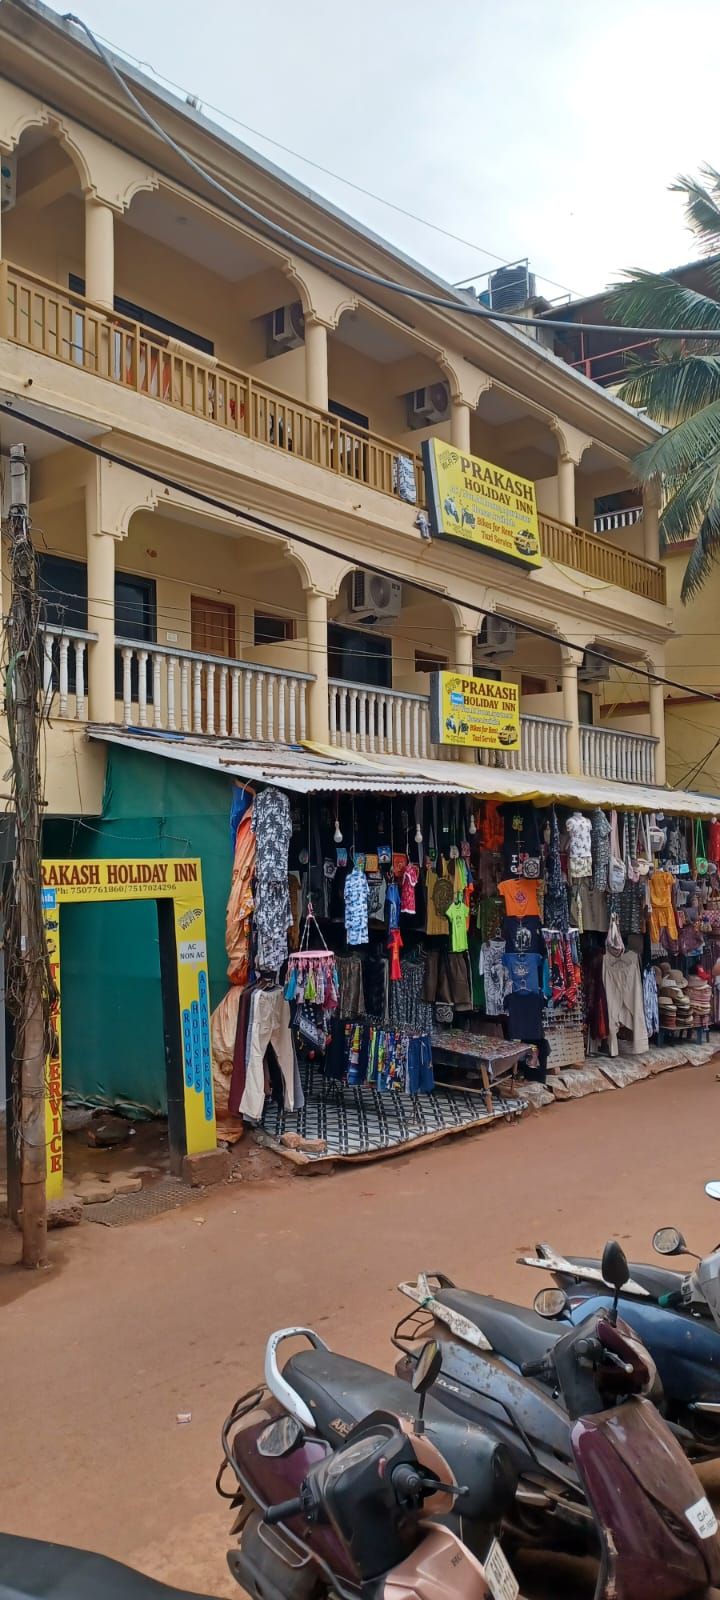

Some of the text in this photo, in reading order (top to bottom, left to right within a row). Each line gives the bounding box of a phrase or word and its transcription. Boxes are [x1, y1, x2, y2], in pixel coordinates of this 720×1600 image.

[460, 456, 534, 502] PRAKASH
[464, 477, 511, 506] HOLIDAY
[515, 501, 533, 515] INN
[494, 535, 513, 549] Service
[461, 680, 517, 701] PRAKASH
[463, 695, 499, 709] HOLIDAY
[502, 702, 516, 712] INN
[41, 863, 198, 886] RAKASH HOLIDAY INN
[180, 952, 194, 960] NON
[184, 1012, 192, 1085] ROOMS
[192, 1005, 201, 1092] HOUSES
[200, 974, 212, 1116] APARTMENTS
[49, 1056, 61, 1173] ERVICE
